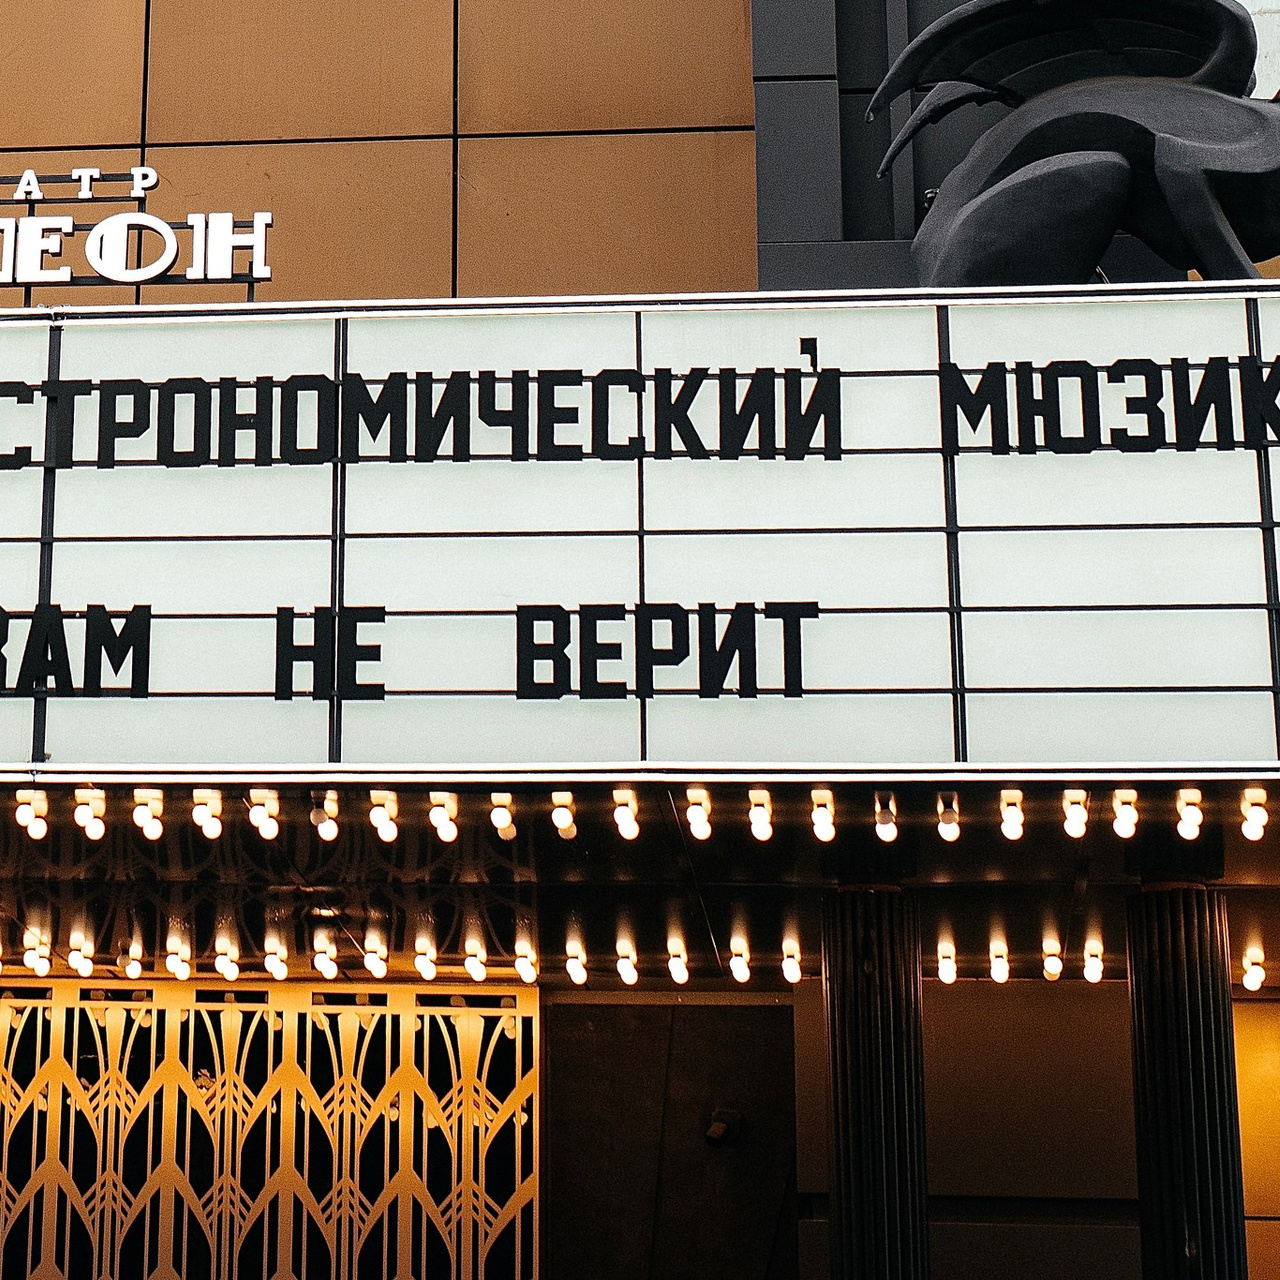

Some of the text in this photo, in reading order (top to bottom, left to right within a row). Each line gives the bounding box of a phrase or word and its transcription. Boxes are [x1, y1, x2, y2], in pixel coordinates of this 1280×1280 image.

[939, 355, 1280, 456] МЮЗИК
[274, 606, 386, 701] НЕ
[516, 601, 819, 700] ВЕРИТ
